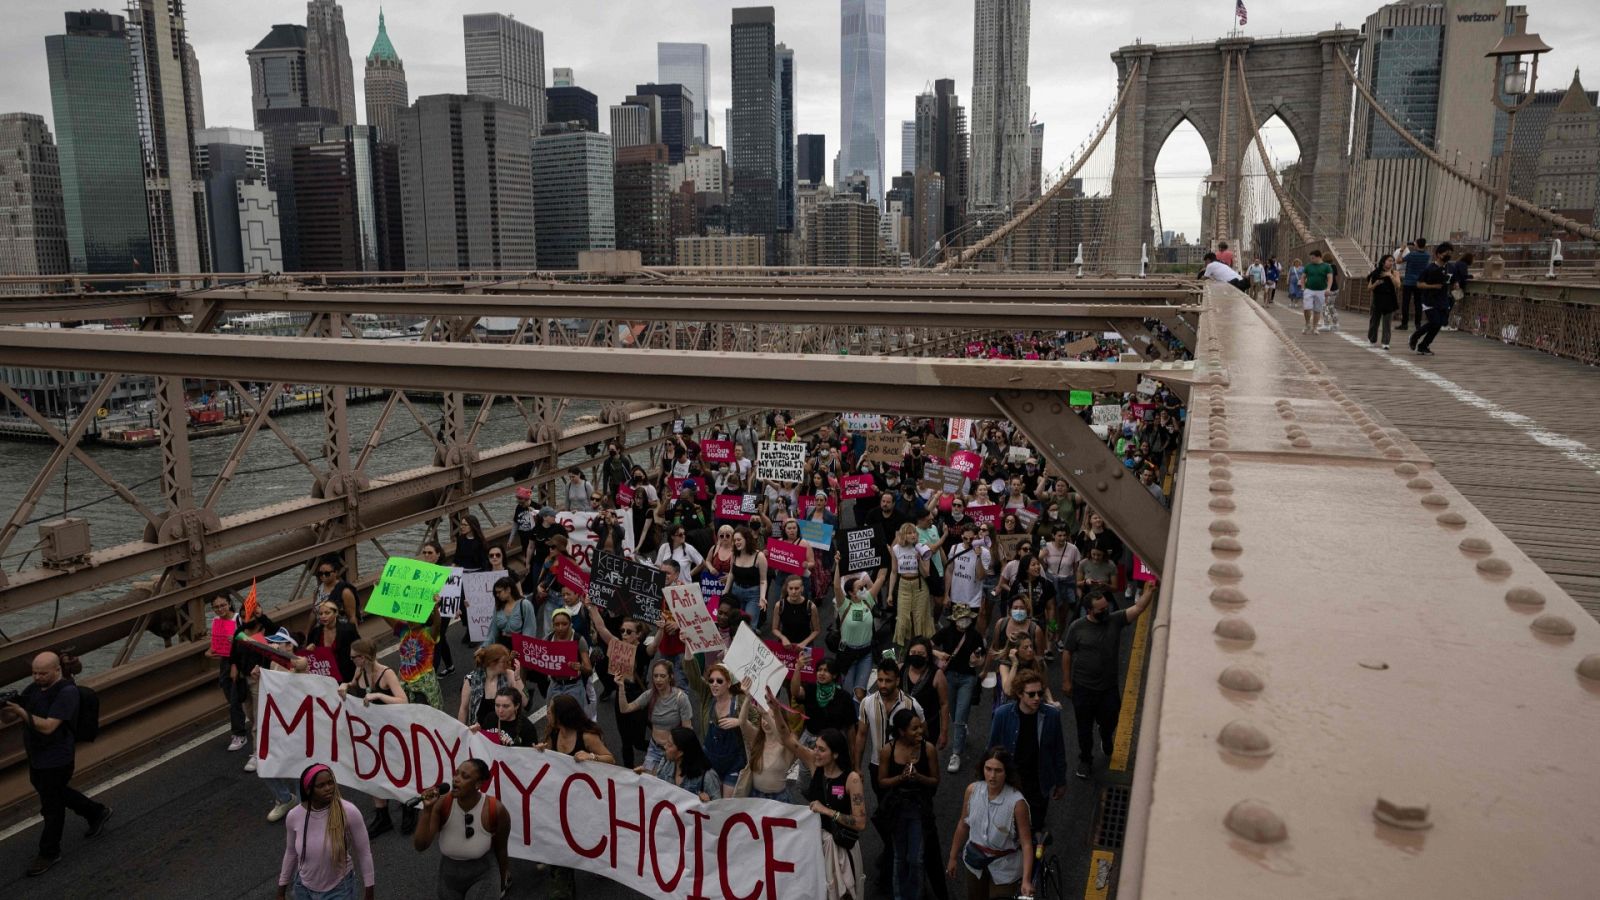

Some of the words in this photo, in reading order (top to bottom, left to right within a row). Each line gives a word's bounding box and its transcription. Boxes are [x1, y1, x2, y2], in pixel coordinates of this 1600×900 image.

[1457, 12, 1497, 22] verizon
[762, 442, 770, 450] IF
[780, 443, 804, 452] WANTED
[760, 451, 790, 460] POLITICS
[790, 452, 800, 460] IN
[758, 459, 769, 467] MY
[758, 468, 773, 478] FUCK
[774, 468, 779, 479] A
[779, 468, 802, 481] SENATOR
[848, 529, 874, 540] STAND
[849, 541, 870, 551] WITH
[849, 549, 875, 560] BLACK
[597, 551, 628, 573] KEEP
[849, 558, 881, 569] WOMEN
[597, 569, 623, 585] SAFE
[630, 578, 659, 597] LEGAL
[635, 595, 655, 608] SAFE
[671, 588, 696, 608] Anti
[675, 610, 711, 628] Abortion
[522, 641, 547, 655] BANS
[523, 648, 542, 659] OFF
[541, 652, 566, 664] OUR
[524, 654, 562, 671] BODIES
[313, 660, 331, 669] OUR
[259, 693, 341, 762] MY
[345, 709, 461, 794] BODY
